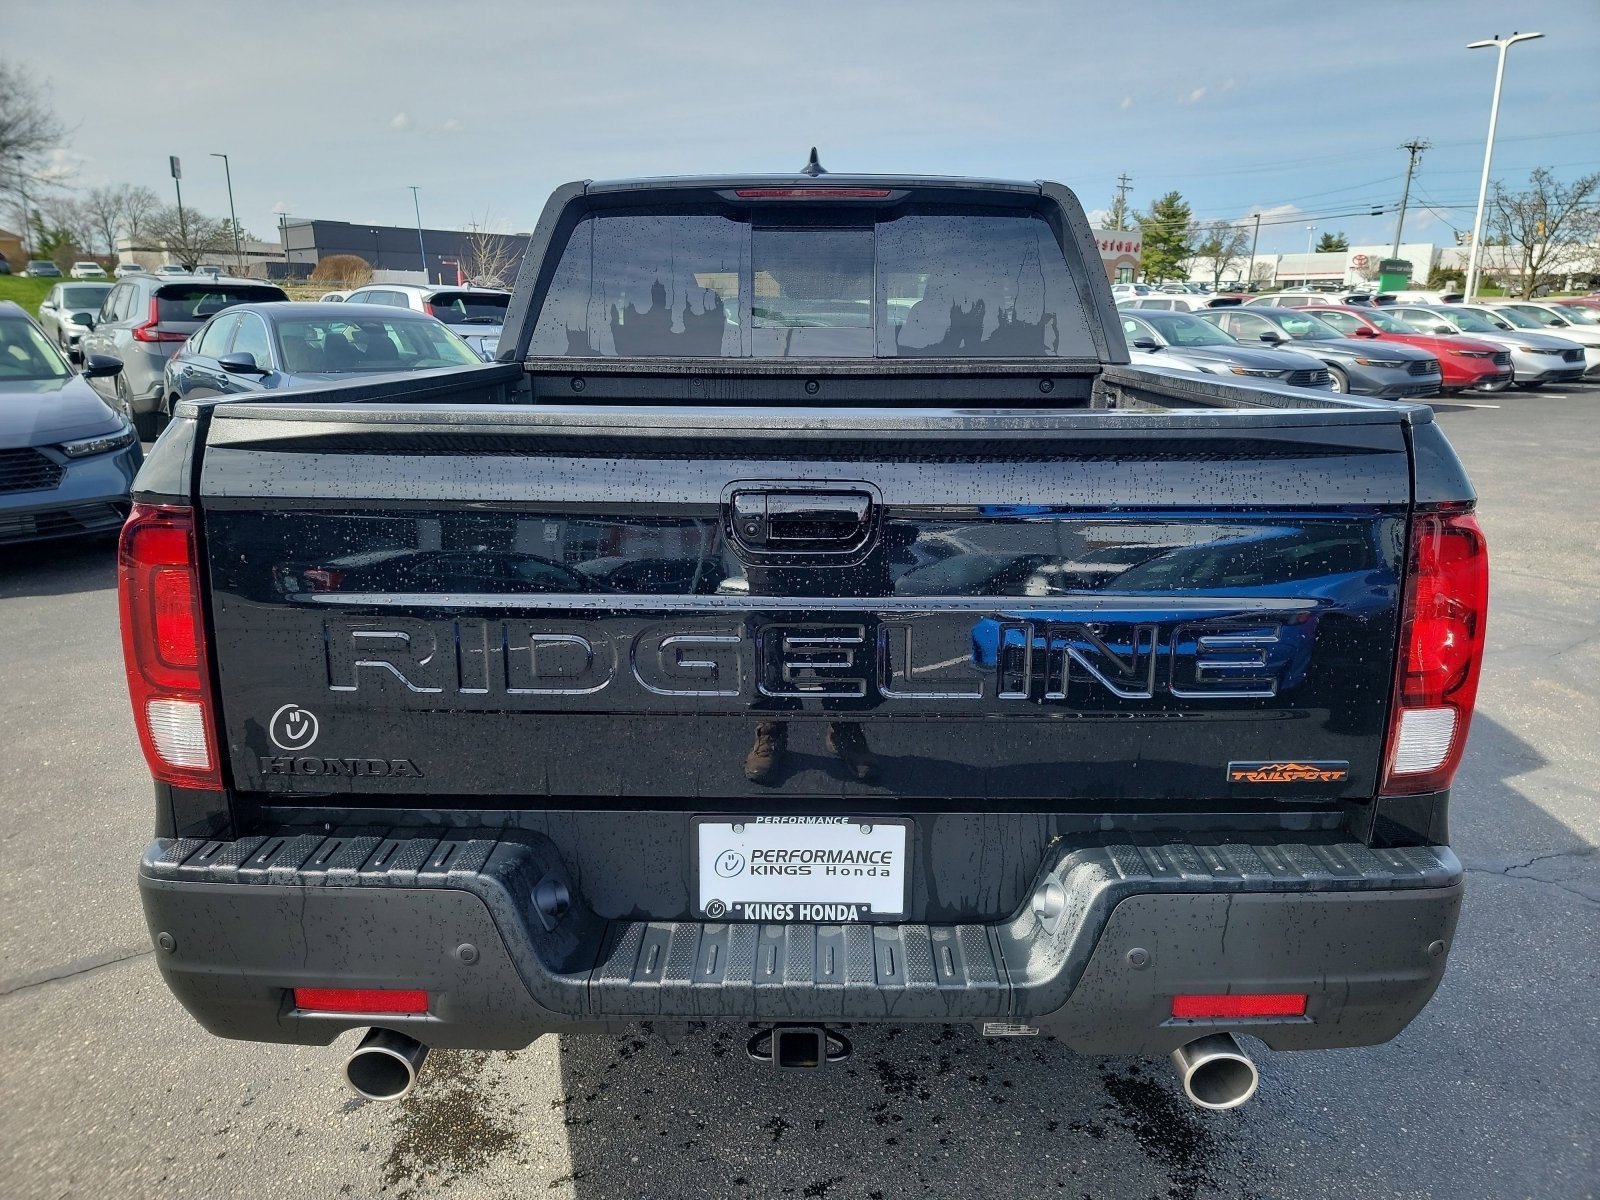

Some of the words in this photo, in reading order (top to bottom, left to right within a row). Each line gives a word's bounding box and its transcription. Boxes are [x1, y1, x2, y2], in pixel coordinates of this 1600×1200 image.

[323, 619, 1282, 700] RIDGELINE
[259, 756, 425, 778] HONDA
[1231, 771, 1346, 782] TRAILSPORT
[755, 816, 849, 825] PERFORMANCE
[750, 849, 893, 865] PERFORMANCE
[750, 865, 812, 876] KINGS
[825, 866, 891, 877] Honda
[744, 903, 794, 920] KINGS
[799, 905, 859, 921] HONDA
